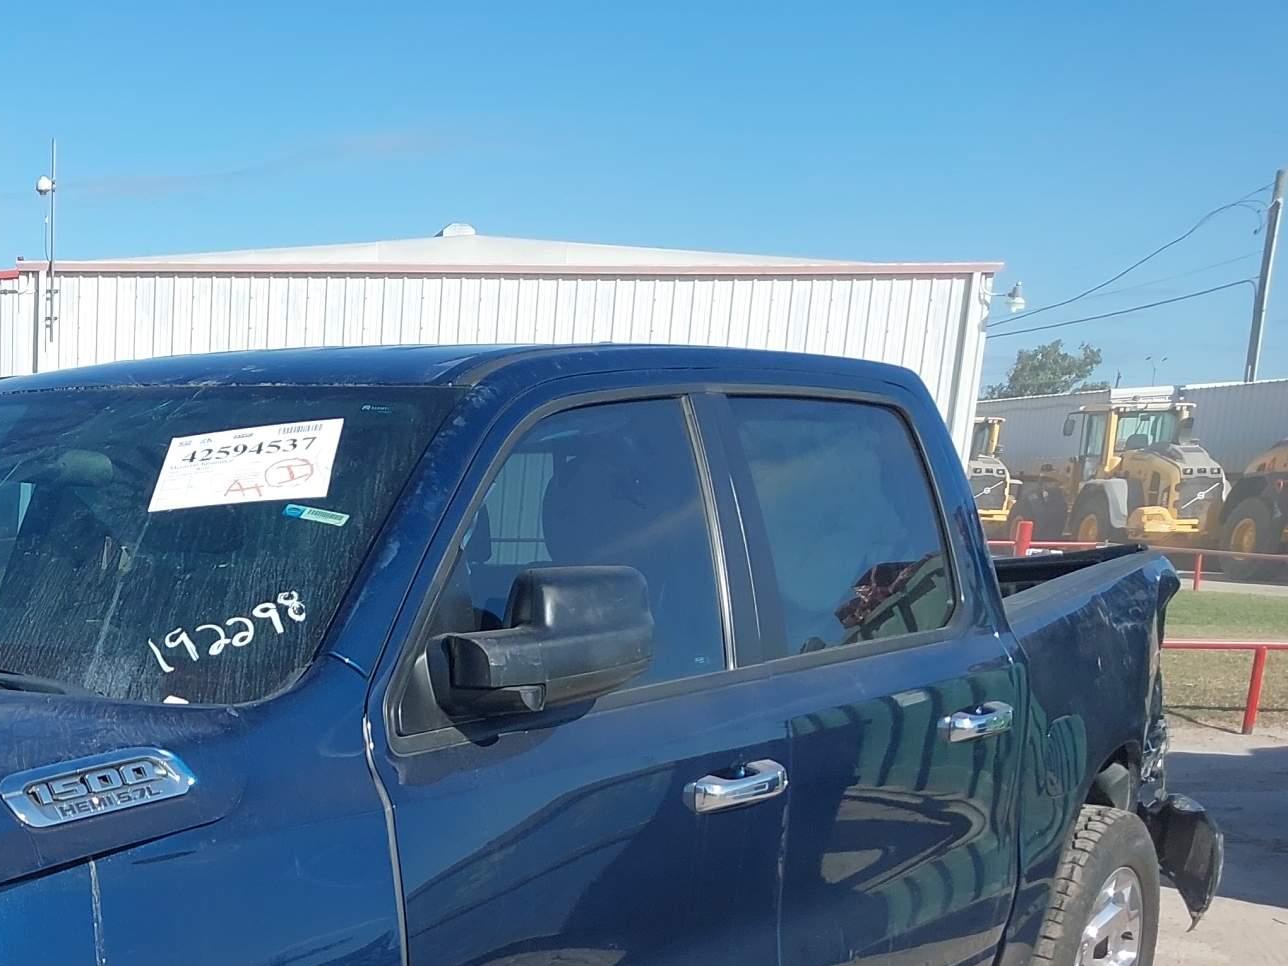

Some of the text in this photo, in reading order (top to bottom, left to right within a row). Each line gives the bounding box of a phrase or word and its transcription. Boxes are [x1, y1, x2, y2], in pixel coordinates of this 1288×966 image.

[182, 436, 317, 463] 42594537
[148, 590, 306, 673] 192298
[27, 760, 155, 806] 1500
[57, 794, 114, 819] HEMI
